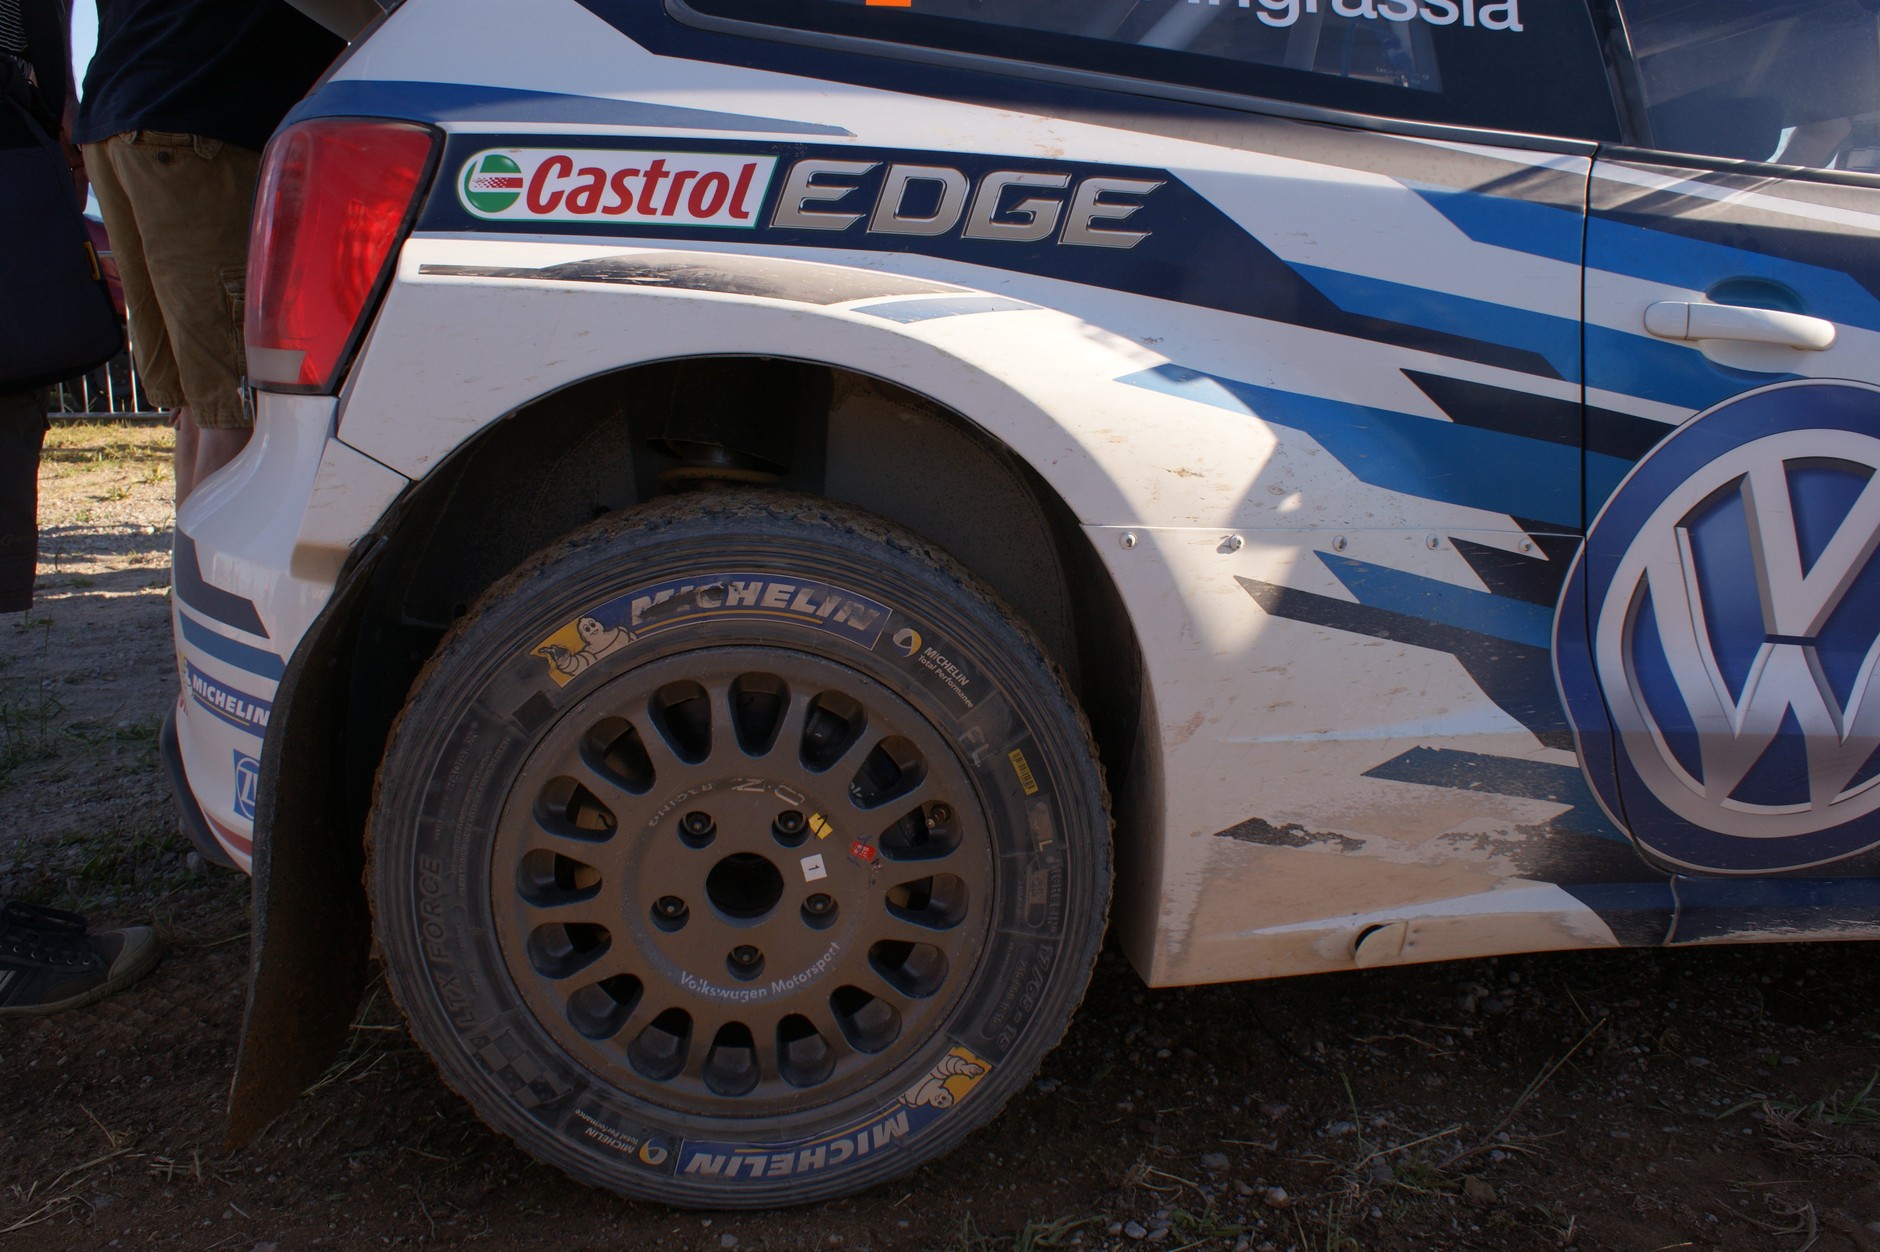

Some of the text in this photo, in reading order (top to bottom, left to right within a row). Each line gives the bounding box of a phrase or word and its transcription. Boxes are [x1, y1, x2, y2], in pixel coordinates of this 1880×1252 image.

[525, 155, 1168, 248] Castrol EDGE
[917, 655, 974, 708] Total Performance
[924, 646, 970, 686] MICHELIN
[193, 674, 271, 727] MICHELIN
[421, 855, 449, 963] FORCE
[771, 941, 841, 995] Motorsport
[433, 972, 475, 1031] LTX
[574, 1109, 620, 1139] Performance
[585, 1127, 636, 1154] MICHELIN
[686, 1110, 911, 1177] MICHELIN
